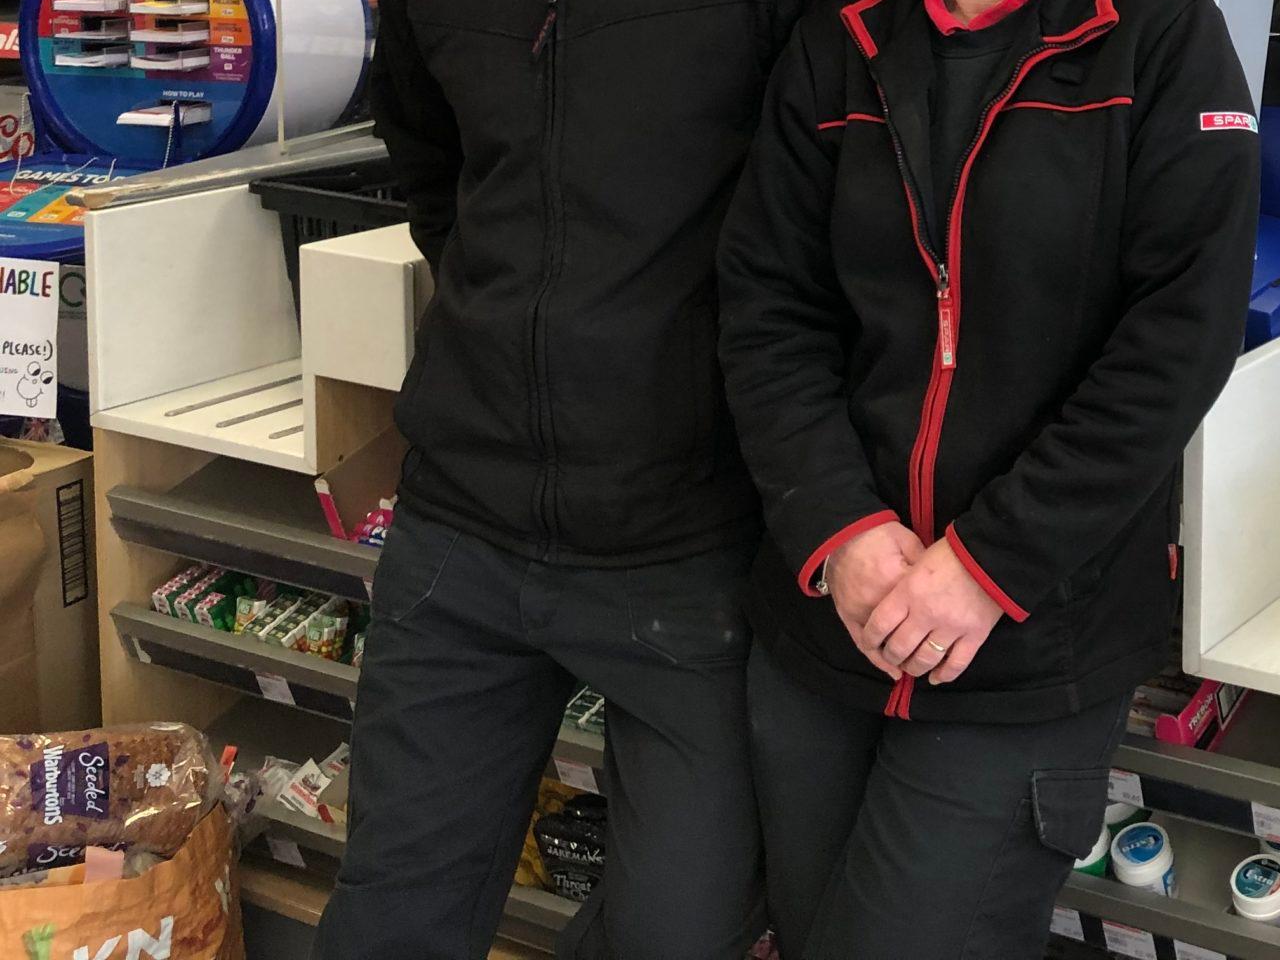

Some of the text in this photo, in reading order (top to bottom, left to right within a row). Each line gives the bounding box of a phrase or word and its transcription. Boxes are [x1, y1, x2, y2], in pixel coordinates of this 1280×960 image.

[1214, 116, 1250, 125] SPAR
[15, 169, 85, 183] GAMES
[42, 745, 64, 825] Warburtons
[78, 751, 105, 813] Seeded
